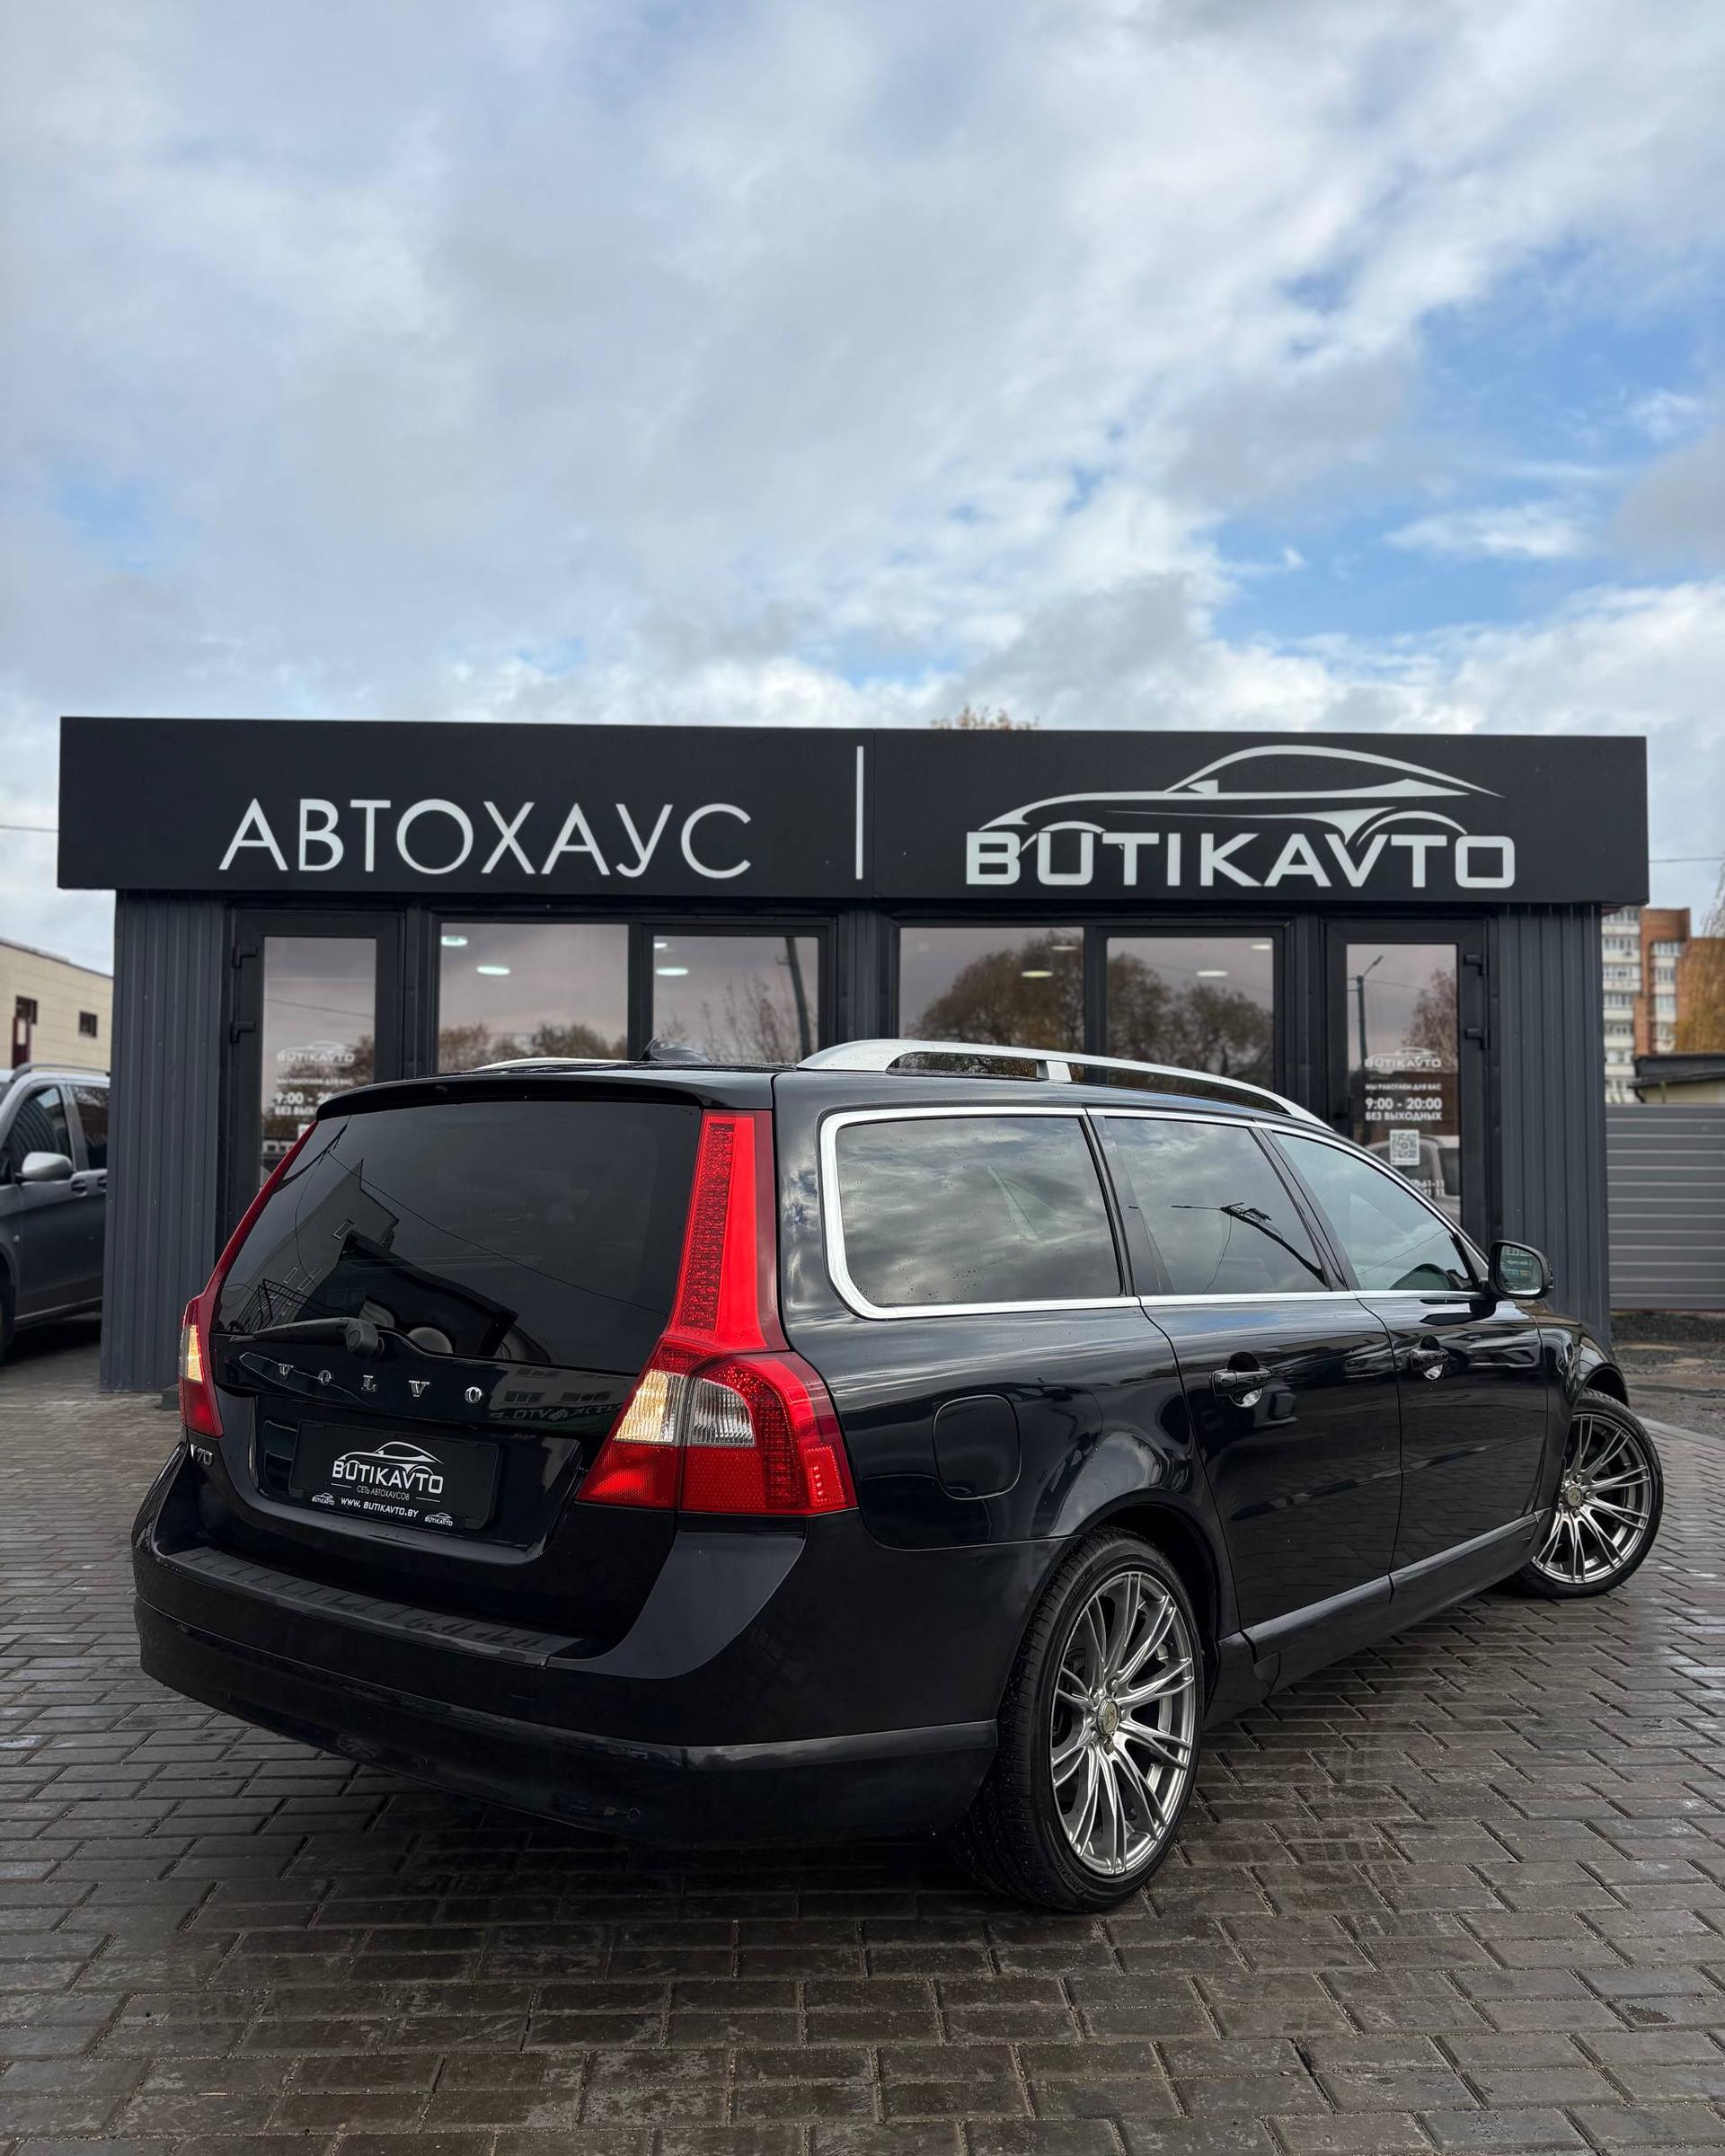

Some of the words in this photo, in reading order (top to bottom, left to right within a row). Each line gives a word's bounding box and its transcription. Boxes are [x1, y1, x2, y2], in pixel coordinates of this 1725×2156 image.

[218, 798, 751, 879] АВТОХАУС
[967, 831, 1516, 888] BUTIKAVTO
[1365, 1057, 1441, 1068] BUTIKAVTO
[276, 1091, 304, 1105] 9:00
[1366, 1098, 1393, 1110] 9:00
[1406, 1097, 1442, 1110] 20:00
[1365, 1111, 1382, 1121] БЕЗ
[1384, 1111, 1442, 1122] ВЫХОДНЫХ
[279, 1363, 482, 1404] VOLVO
[332, 1460, 444, 1495] BUTIKAVTO
[370, 1488, 410, 1501] АВТОХАУСОВ
[341, 1498, 361, 1508] WWW.
[363, 1501, 419, 1518] BUTIKAVTO.BY
